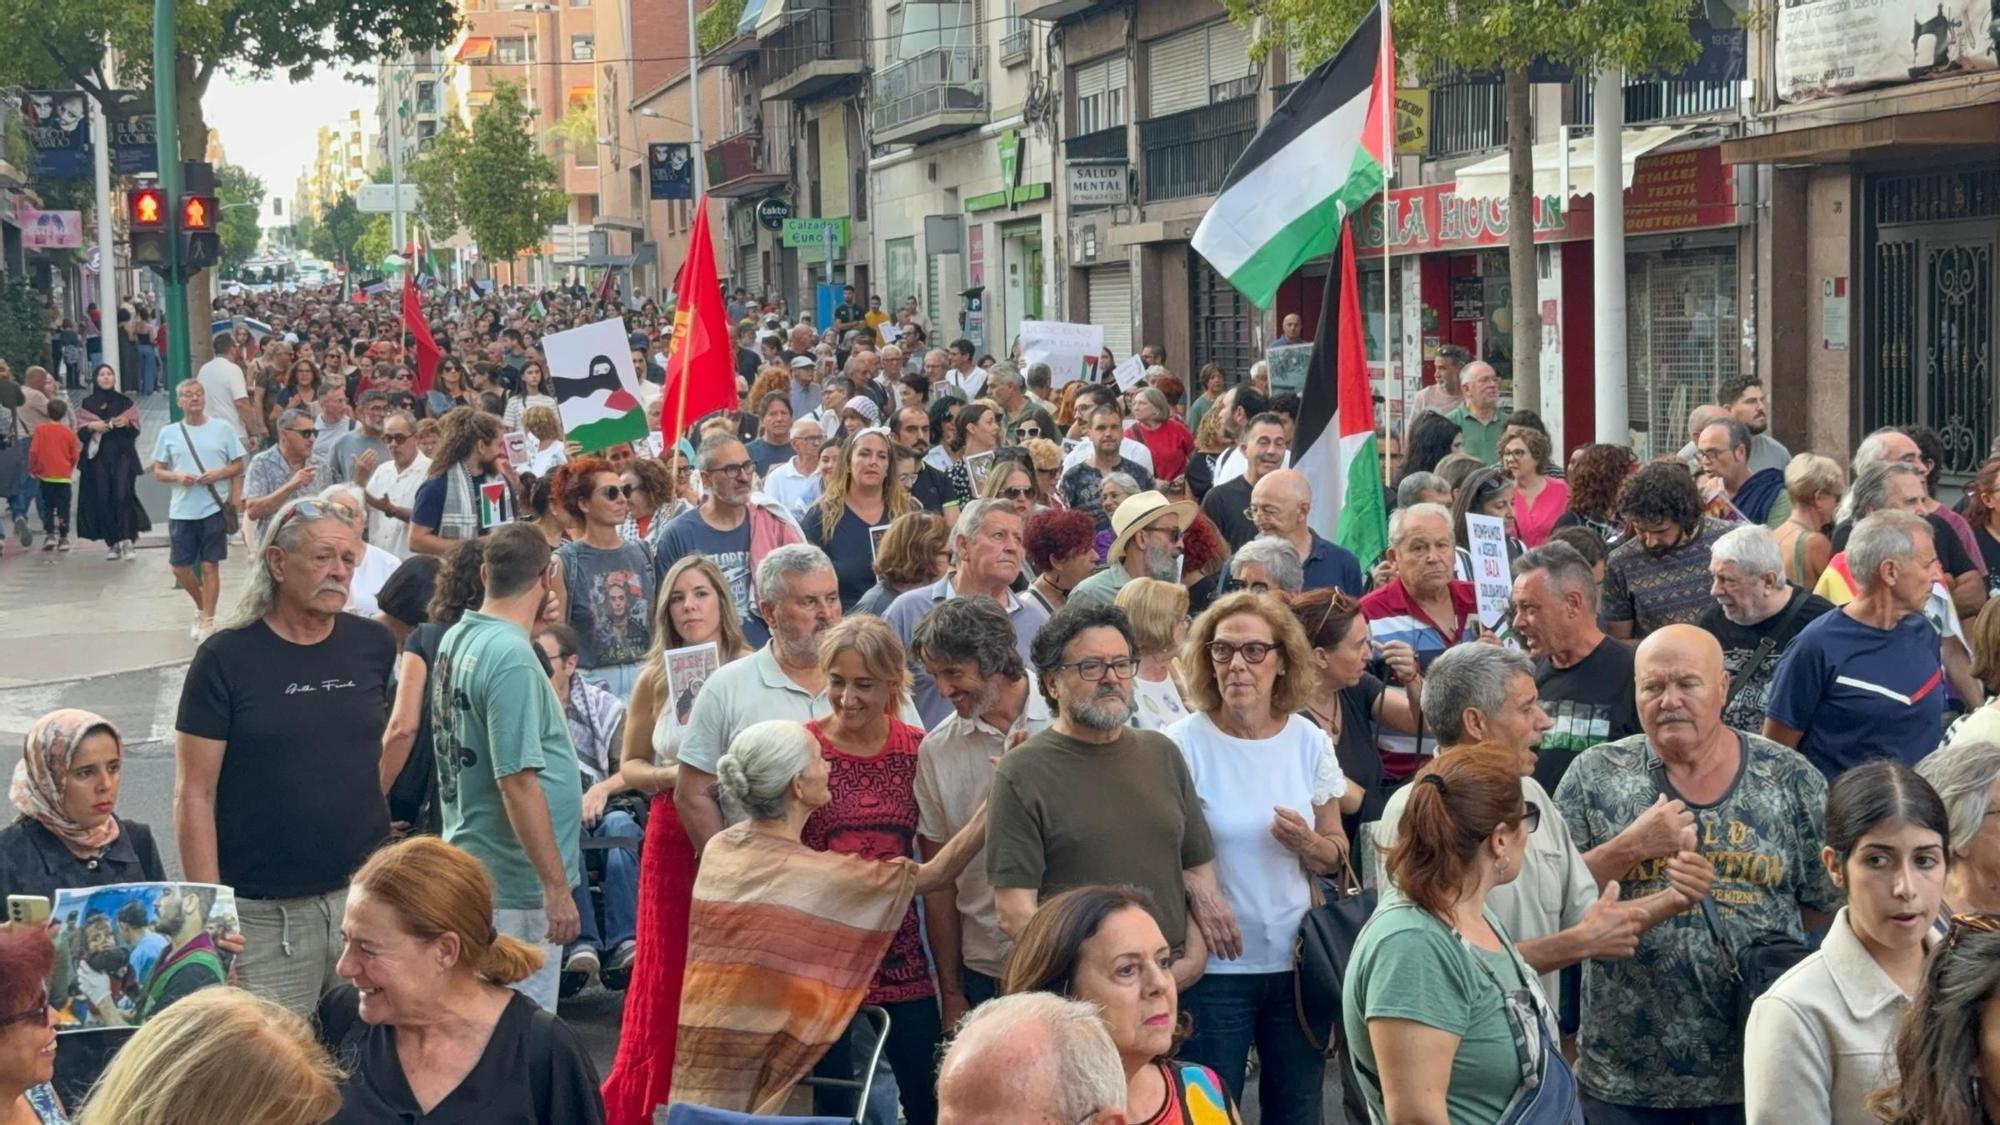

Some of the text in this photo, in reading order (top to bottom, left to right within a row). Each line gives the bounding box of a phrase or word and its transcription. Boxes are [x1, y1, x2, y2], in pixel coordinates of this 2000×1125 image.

[1077, 168, 1117, 179] SALUD
[1073, 181, 1121, 191] MENTAL
[762, 205, 788, 215] takto
[1438, 192, 1566, 238] HOGR
[789, 220, 840, 230] Calzados
